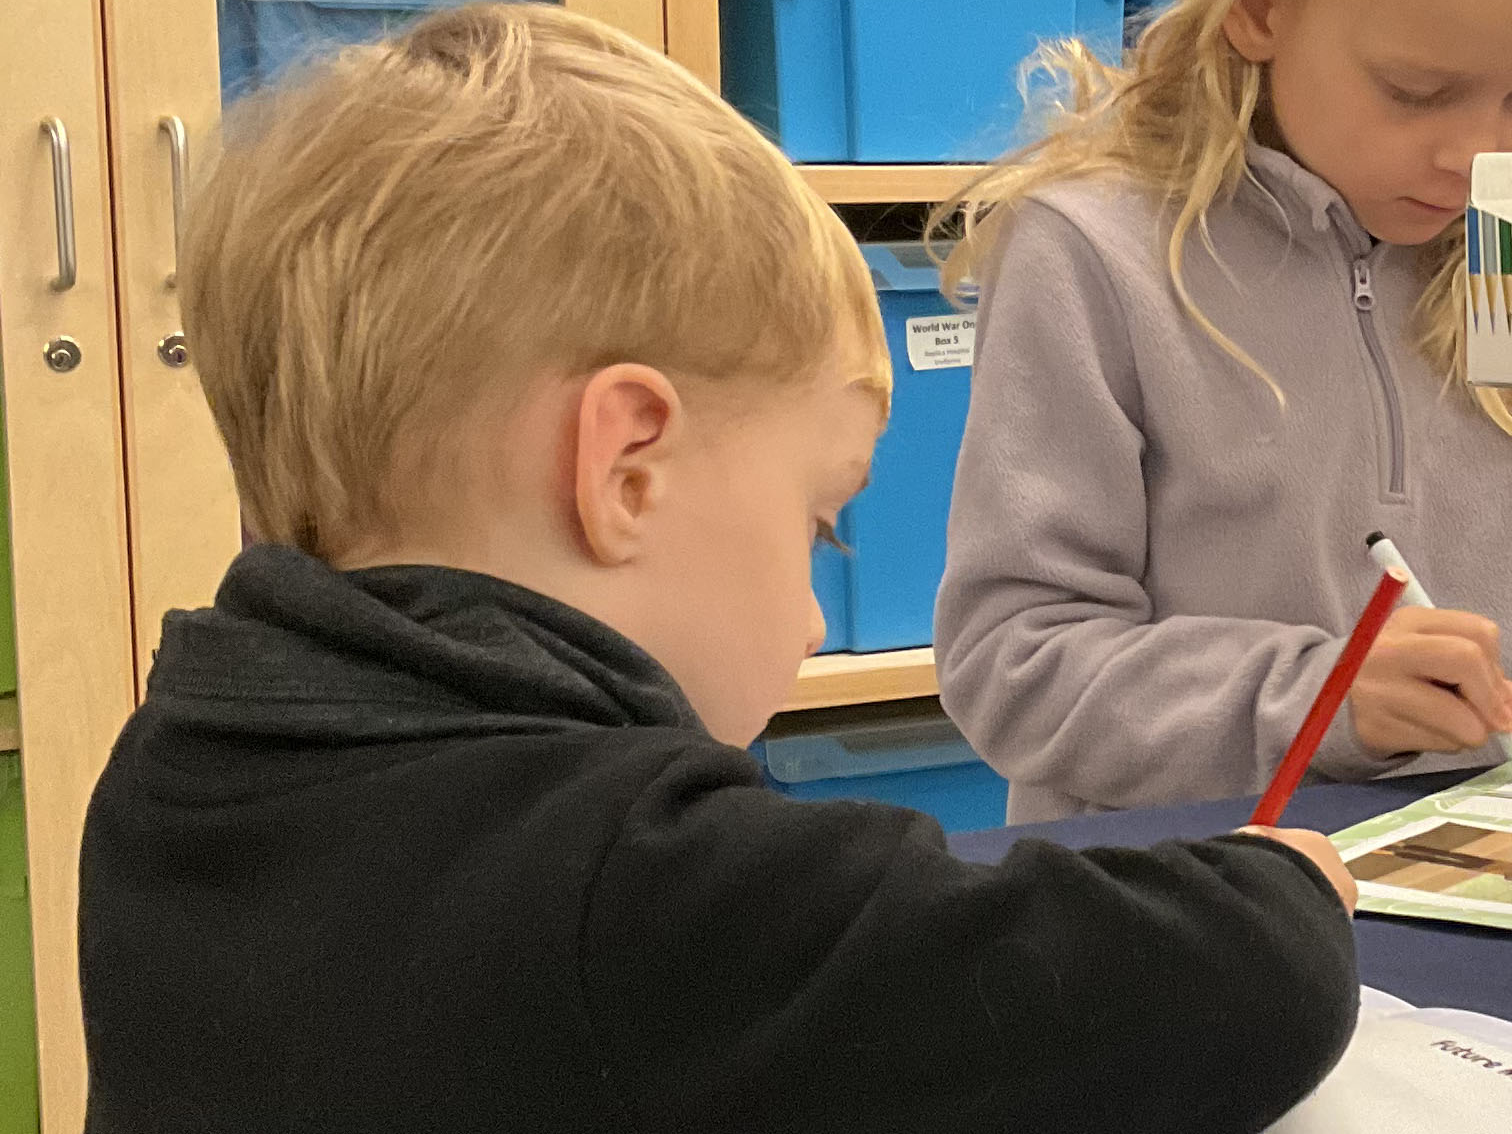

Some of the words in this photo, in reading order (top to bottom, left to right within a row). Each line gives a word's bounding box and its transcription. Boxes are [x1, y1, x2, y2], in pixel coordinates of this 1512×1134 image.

[912, 322, 940, 333] World
[942, 322, 960, 331] War
[962, 320, 975, 329] On
[935, 337, 951, 346] Box
[953, 336, 959, 344] 5
[1431, 1040, 1502, 1068] Future
